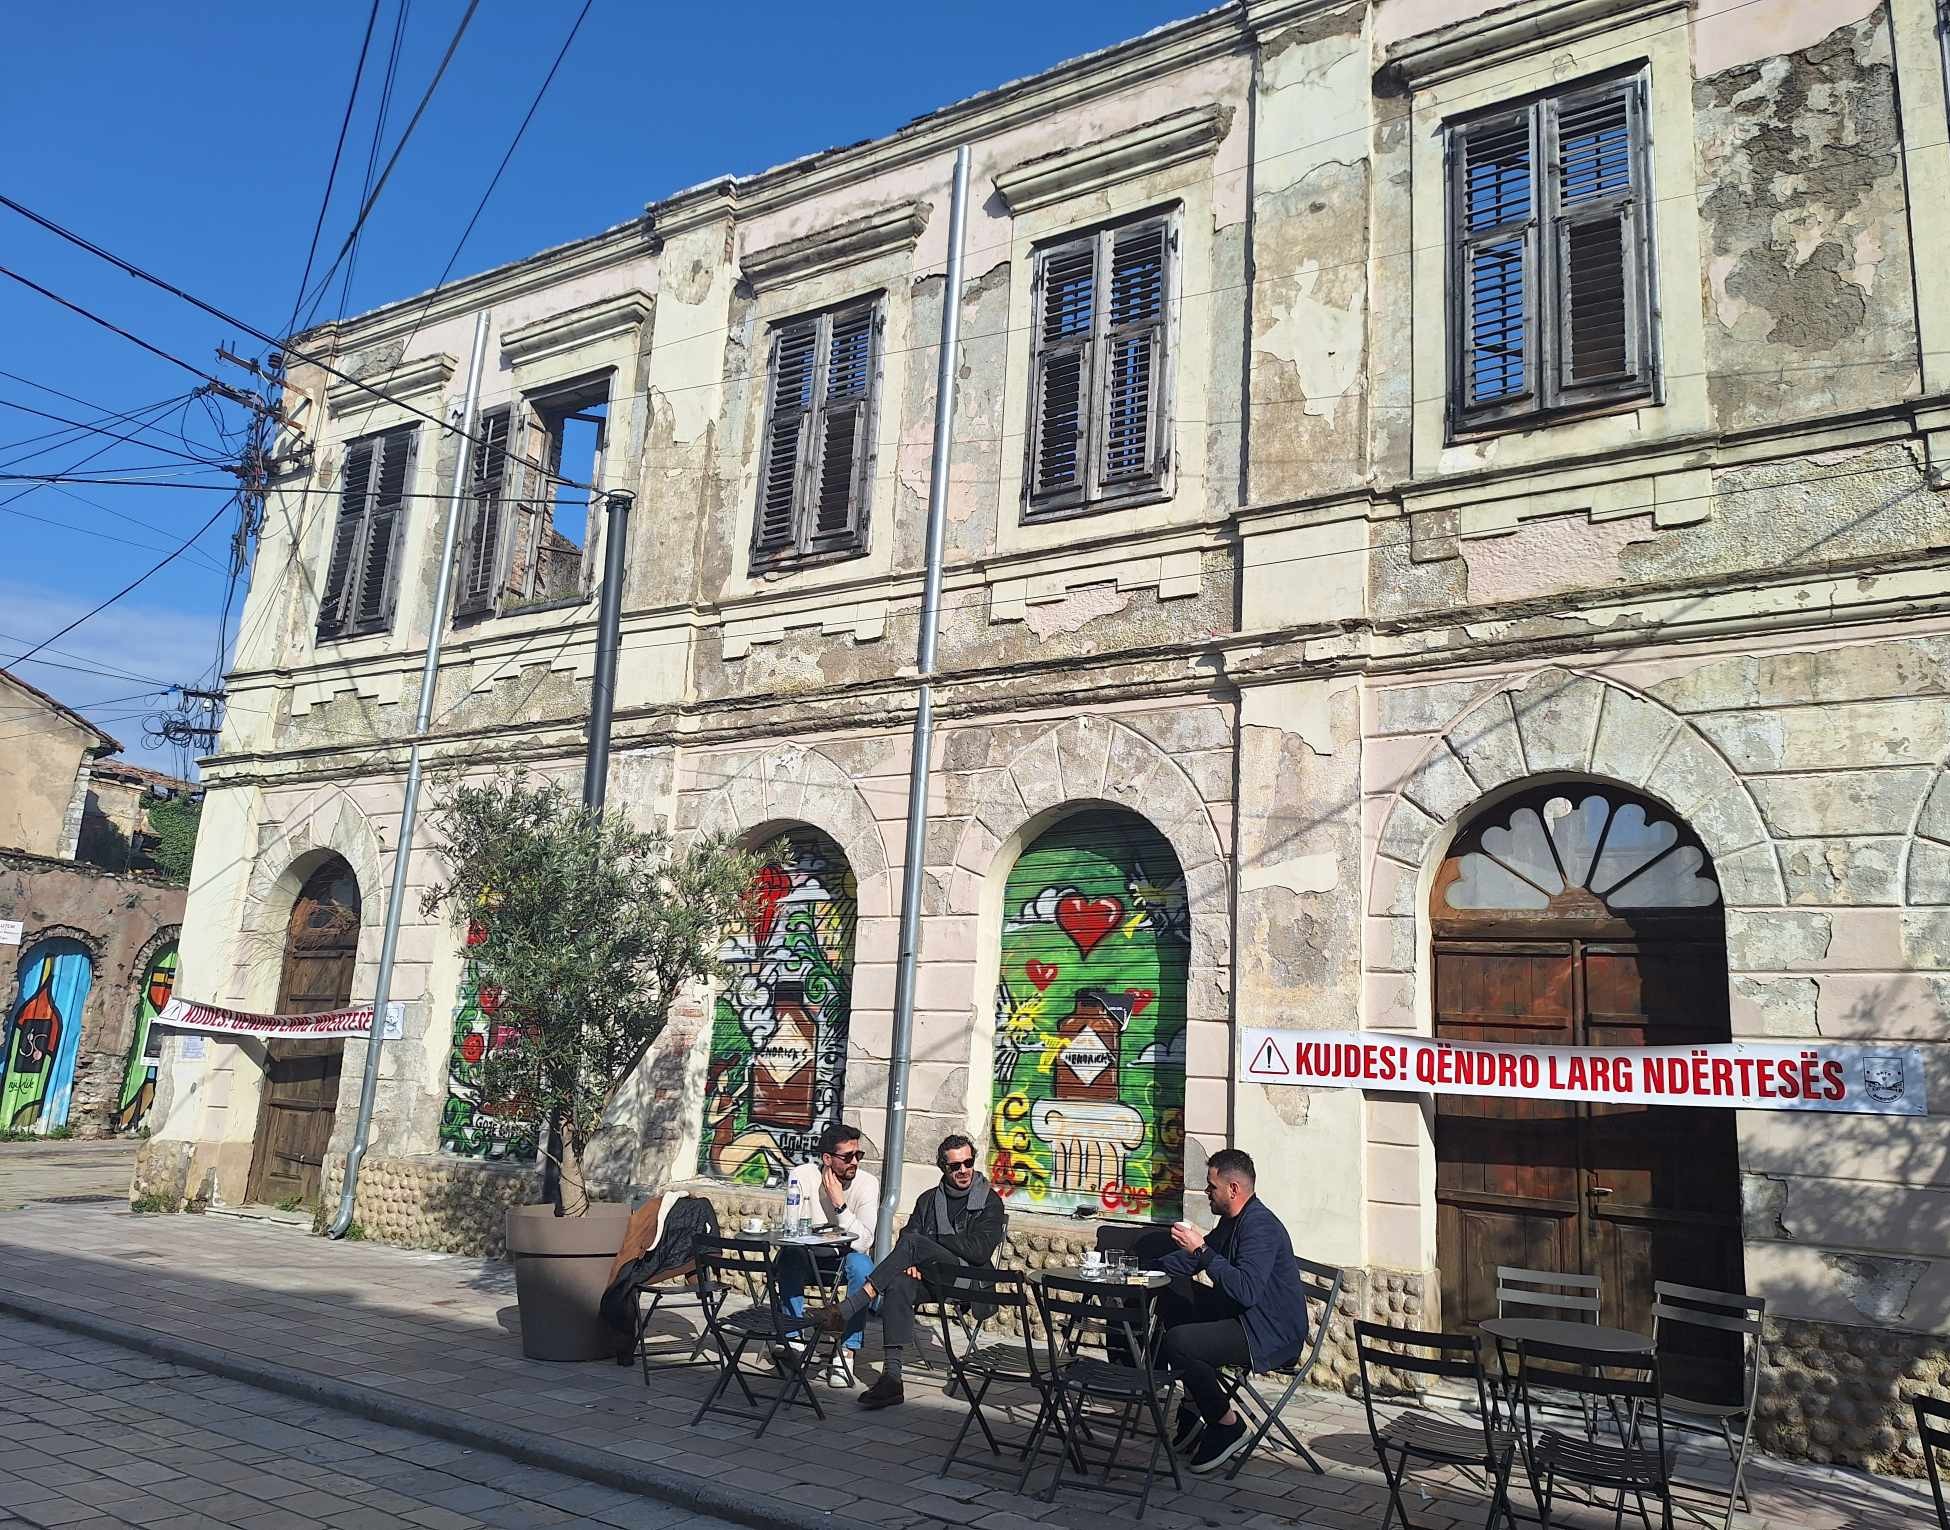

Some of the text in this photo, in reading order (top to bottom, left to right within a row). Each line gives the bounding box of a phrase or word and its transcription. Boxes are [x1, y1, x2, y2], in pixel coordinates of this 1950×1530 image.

[1296, 1042, 1847, 1101] KUJDES! QËNDRO LARG NDËRTESËS
